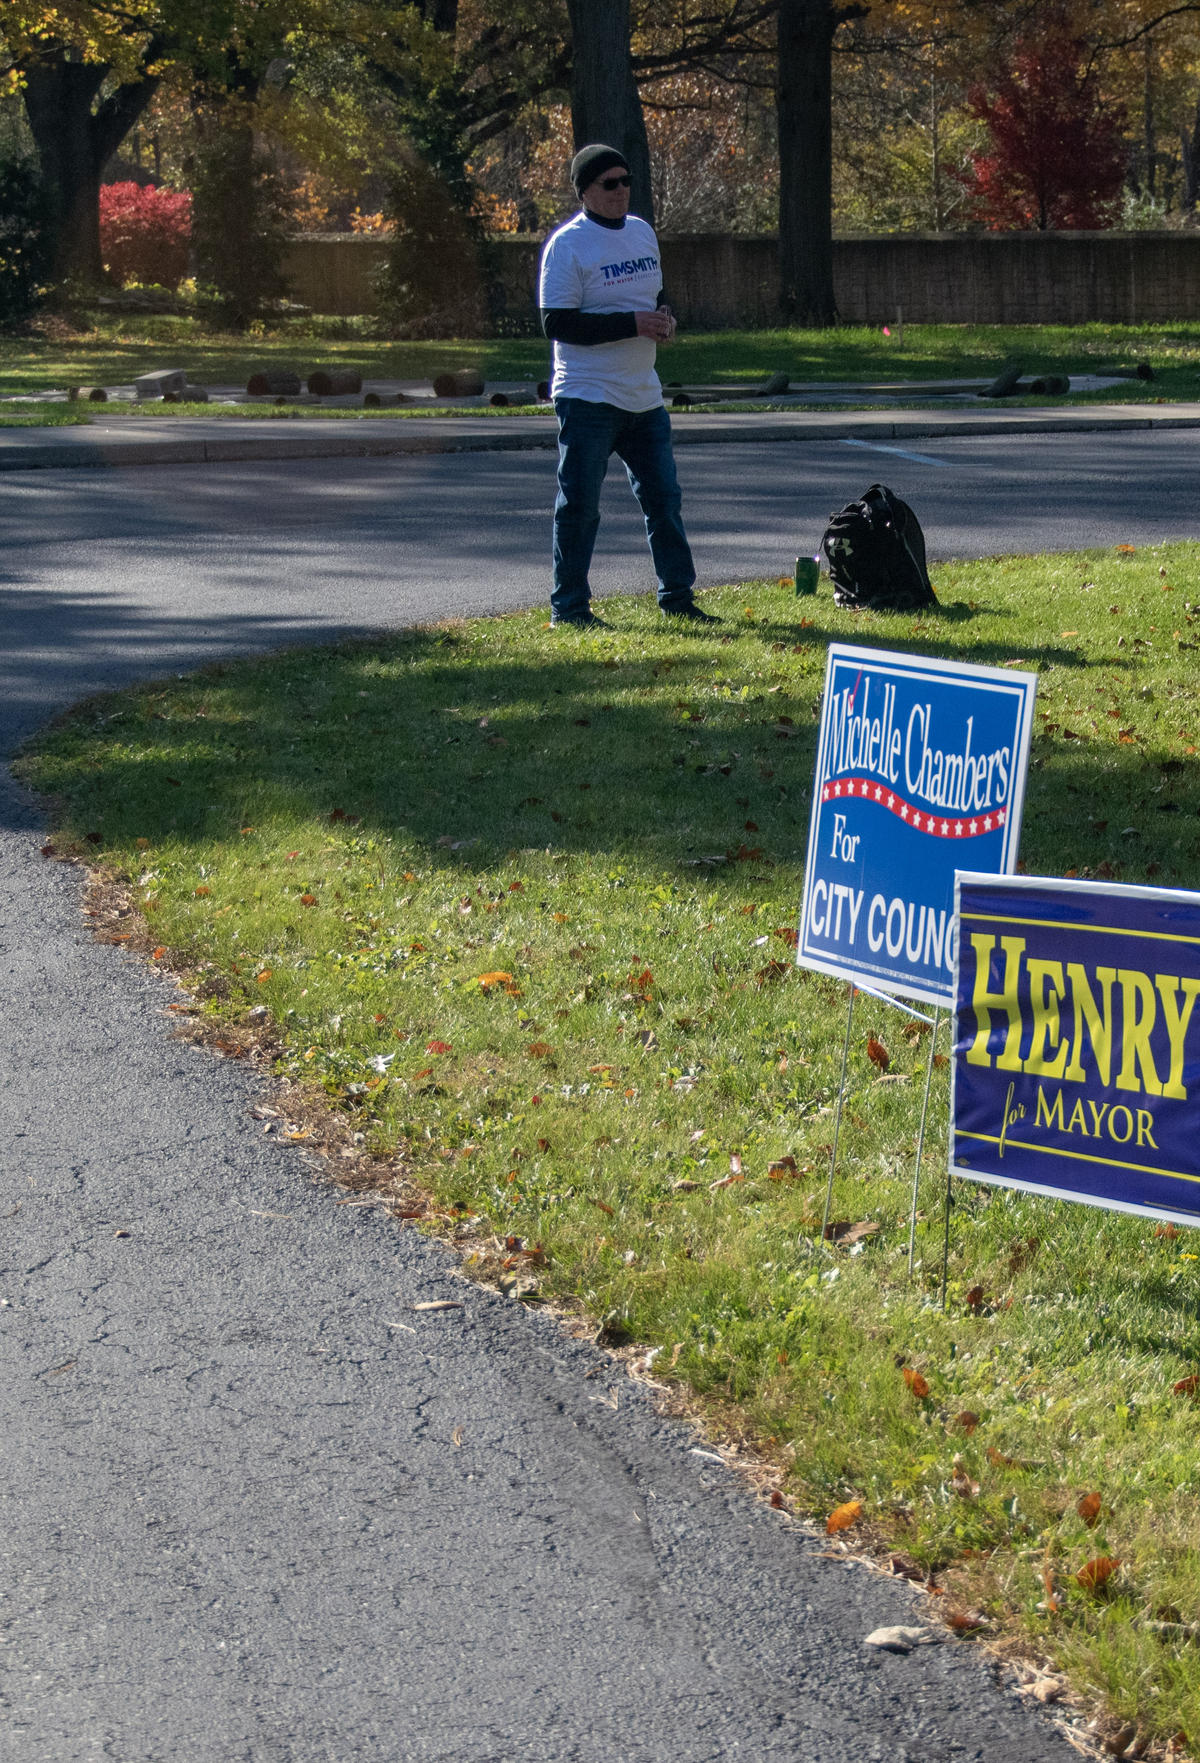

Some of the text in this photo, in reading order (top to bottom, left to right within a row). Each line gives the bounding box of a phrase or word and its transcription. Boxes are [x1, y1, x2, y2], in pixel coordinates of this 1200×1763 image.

[825, 677, 1009, 811] Michelle Chambers
[830, 814, 860, 863] For
[811, 879, 864, 945] CITY
[999, 1082, 1159, 1158] for MAYOR
